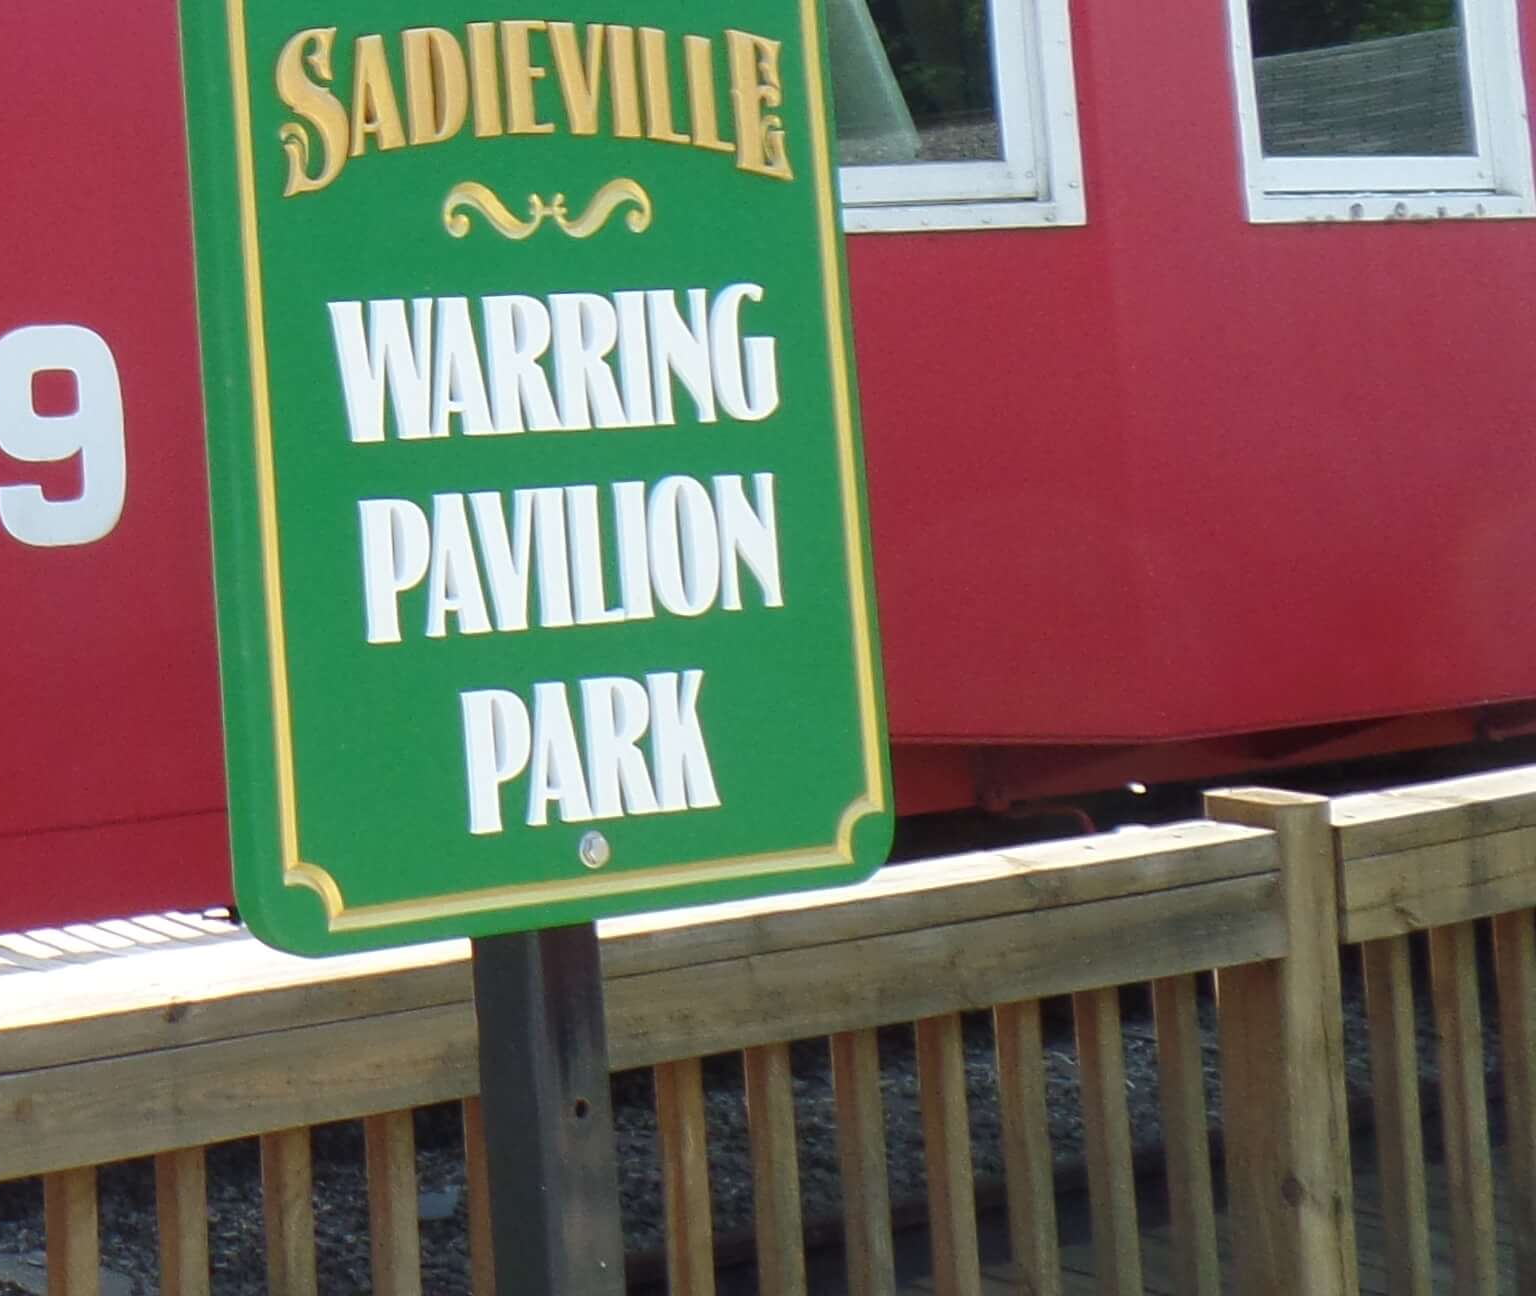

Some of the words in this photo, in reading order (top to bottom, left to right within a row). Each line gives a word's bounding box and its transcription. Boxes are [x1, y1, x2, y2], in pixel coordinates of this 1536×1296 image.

[274, 19, 794, 197] SADIEVILLE
[327, 282, 779, 444] WARRING
[355, 471, 783, 645] PAVILION
[459, 668, 722, 836] PARK
